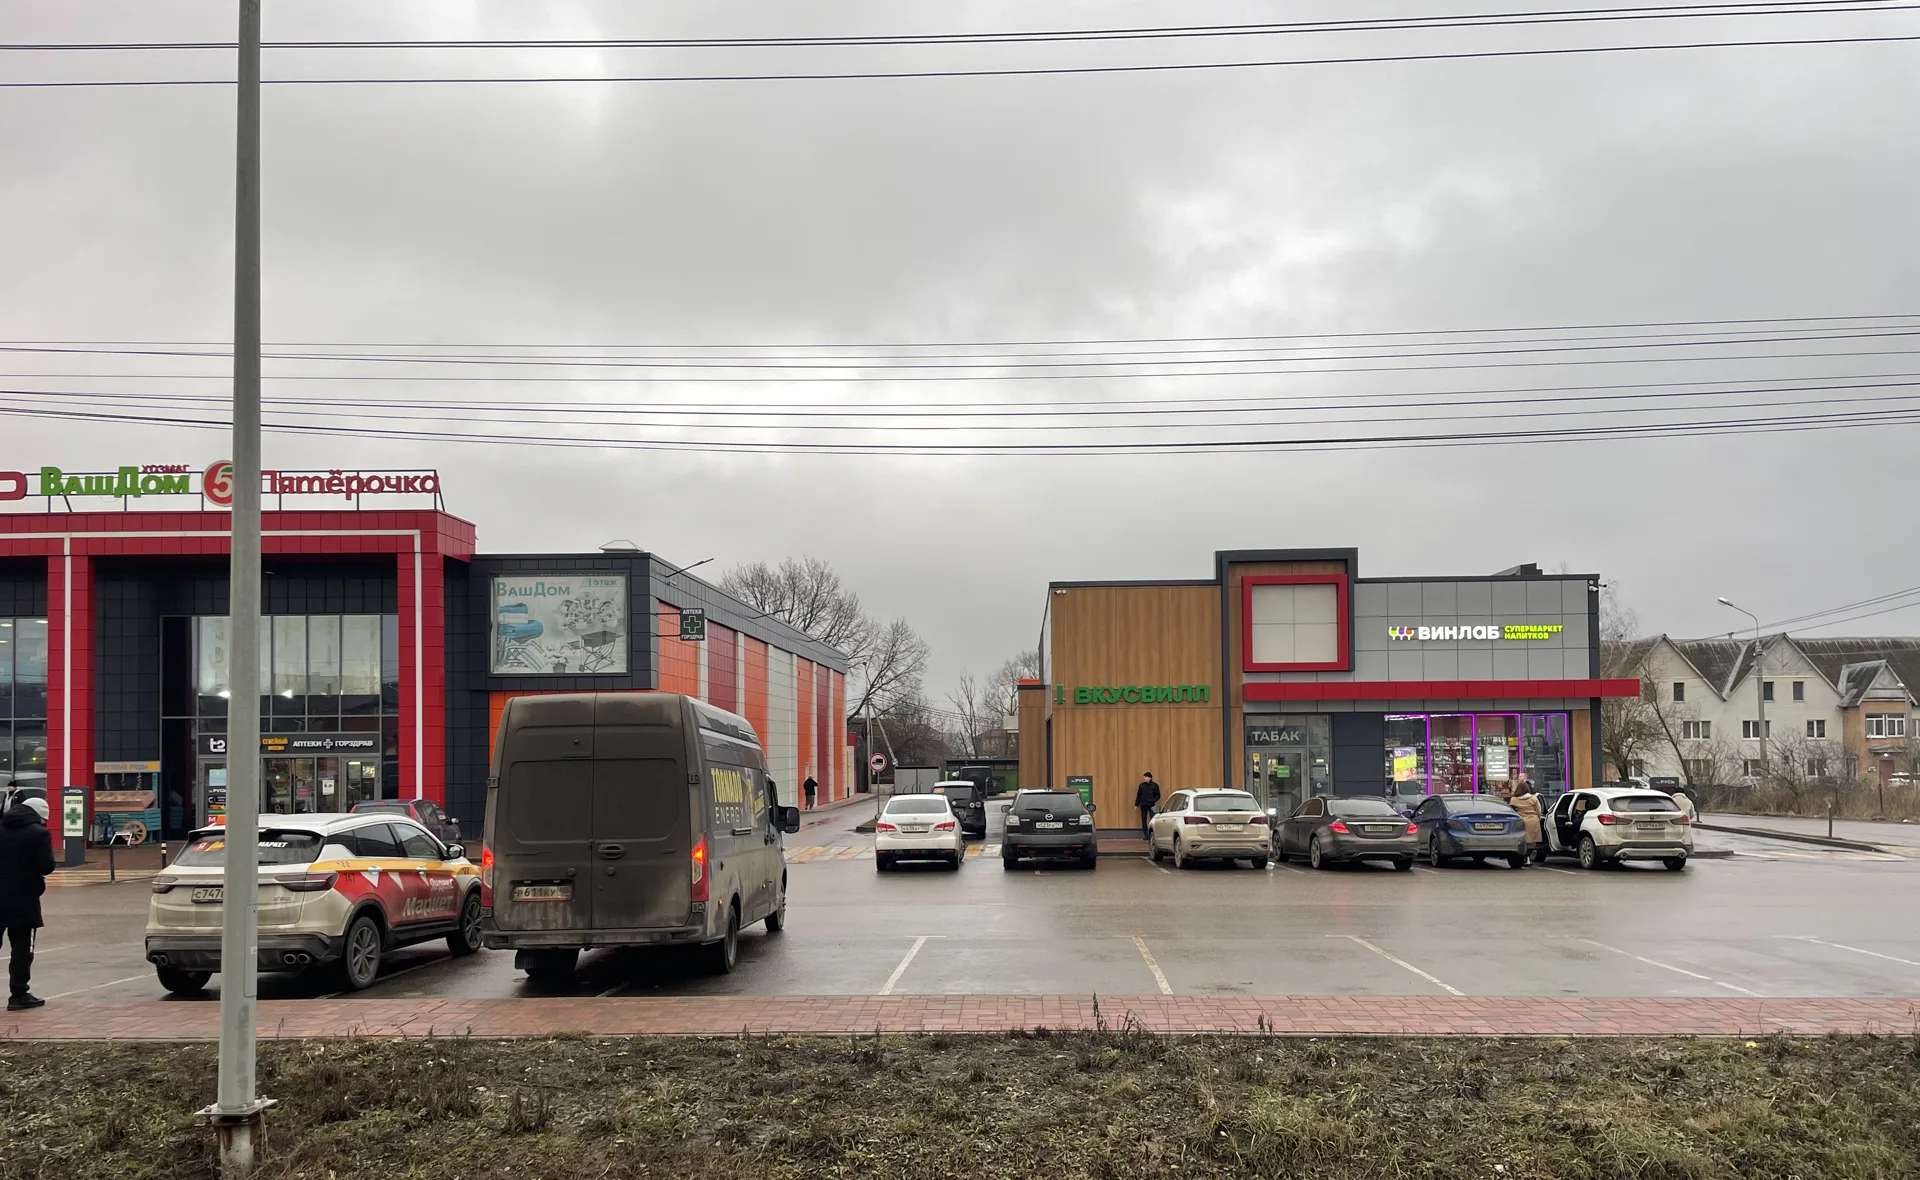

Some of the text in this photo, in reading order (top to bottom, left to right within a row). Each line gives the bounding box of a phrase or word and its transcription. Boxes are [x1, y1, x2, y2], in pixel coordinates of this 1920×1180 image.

[1504, 625, 1562, 633] СУПЕРМАРКЕТ
[1074, 685, 1210, 704] ВКУСВИЛЛ
[1252, 731, 1300, 742] ТАБАК
[292, 740, 322, 748] АПТЕКИ
[334, 740, 374, 748] ГОРЗДРАВ
[710, 767, 744, 804] TORNADO
[715, 806, 744, 824] ENERGY
[402, 895, 455, 917] Маркет
